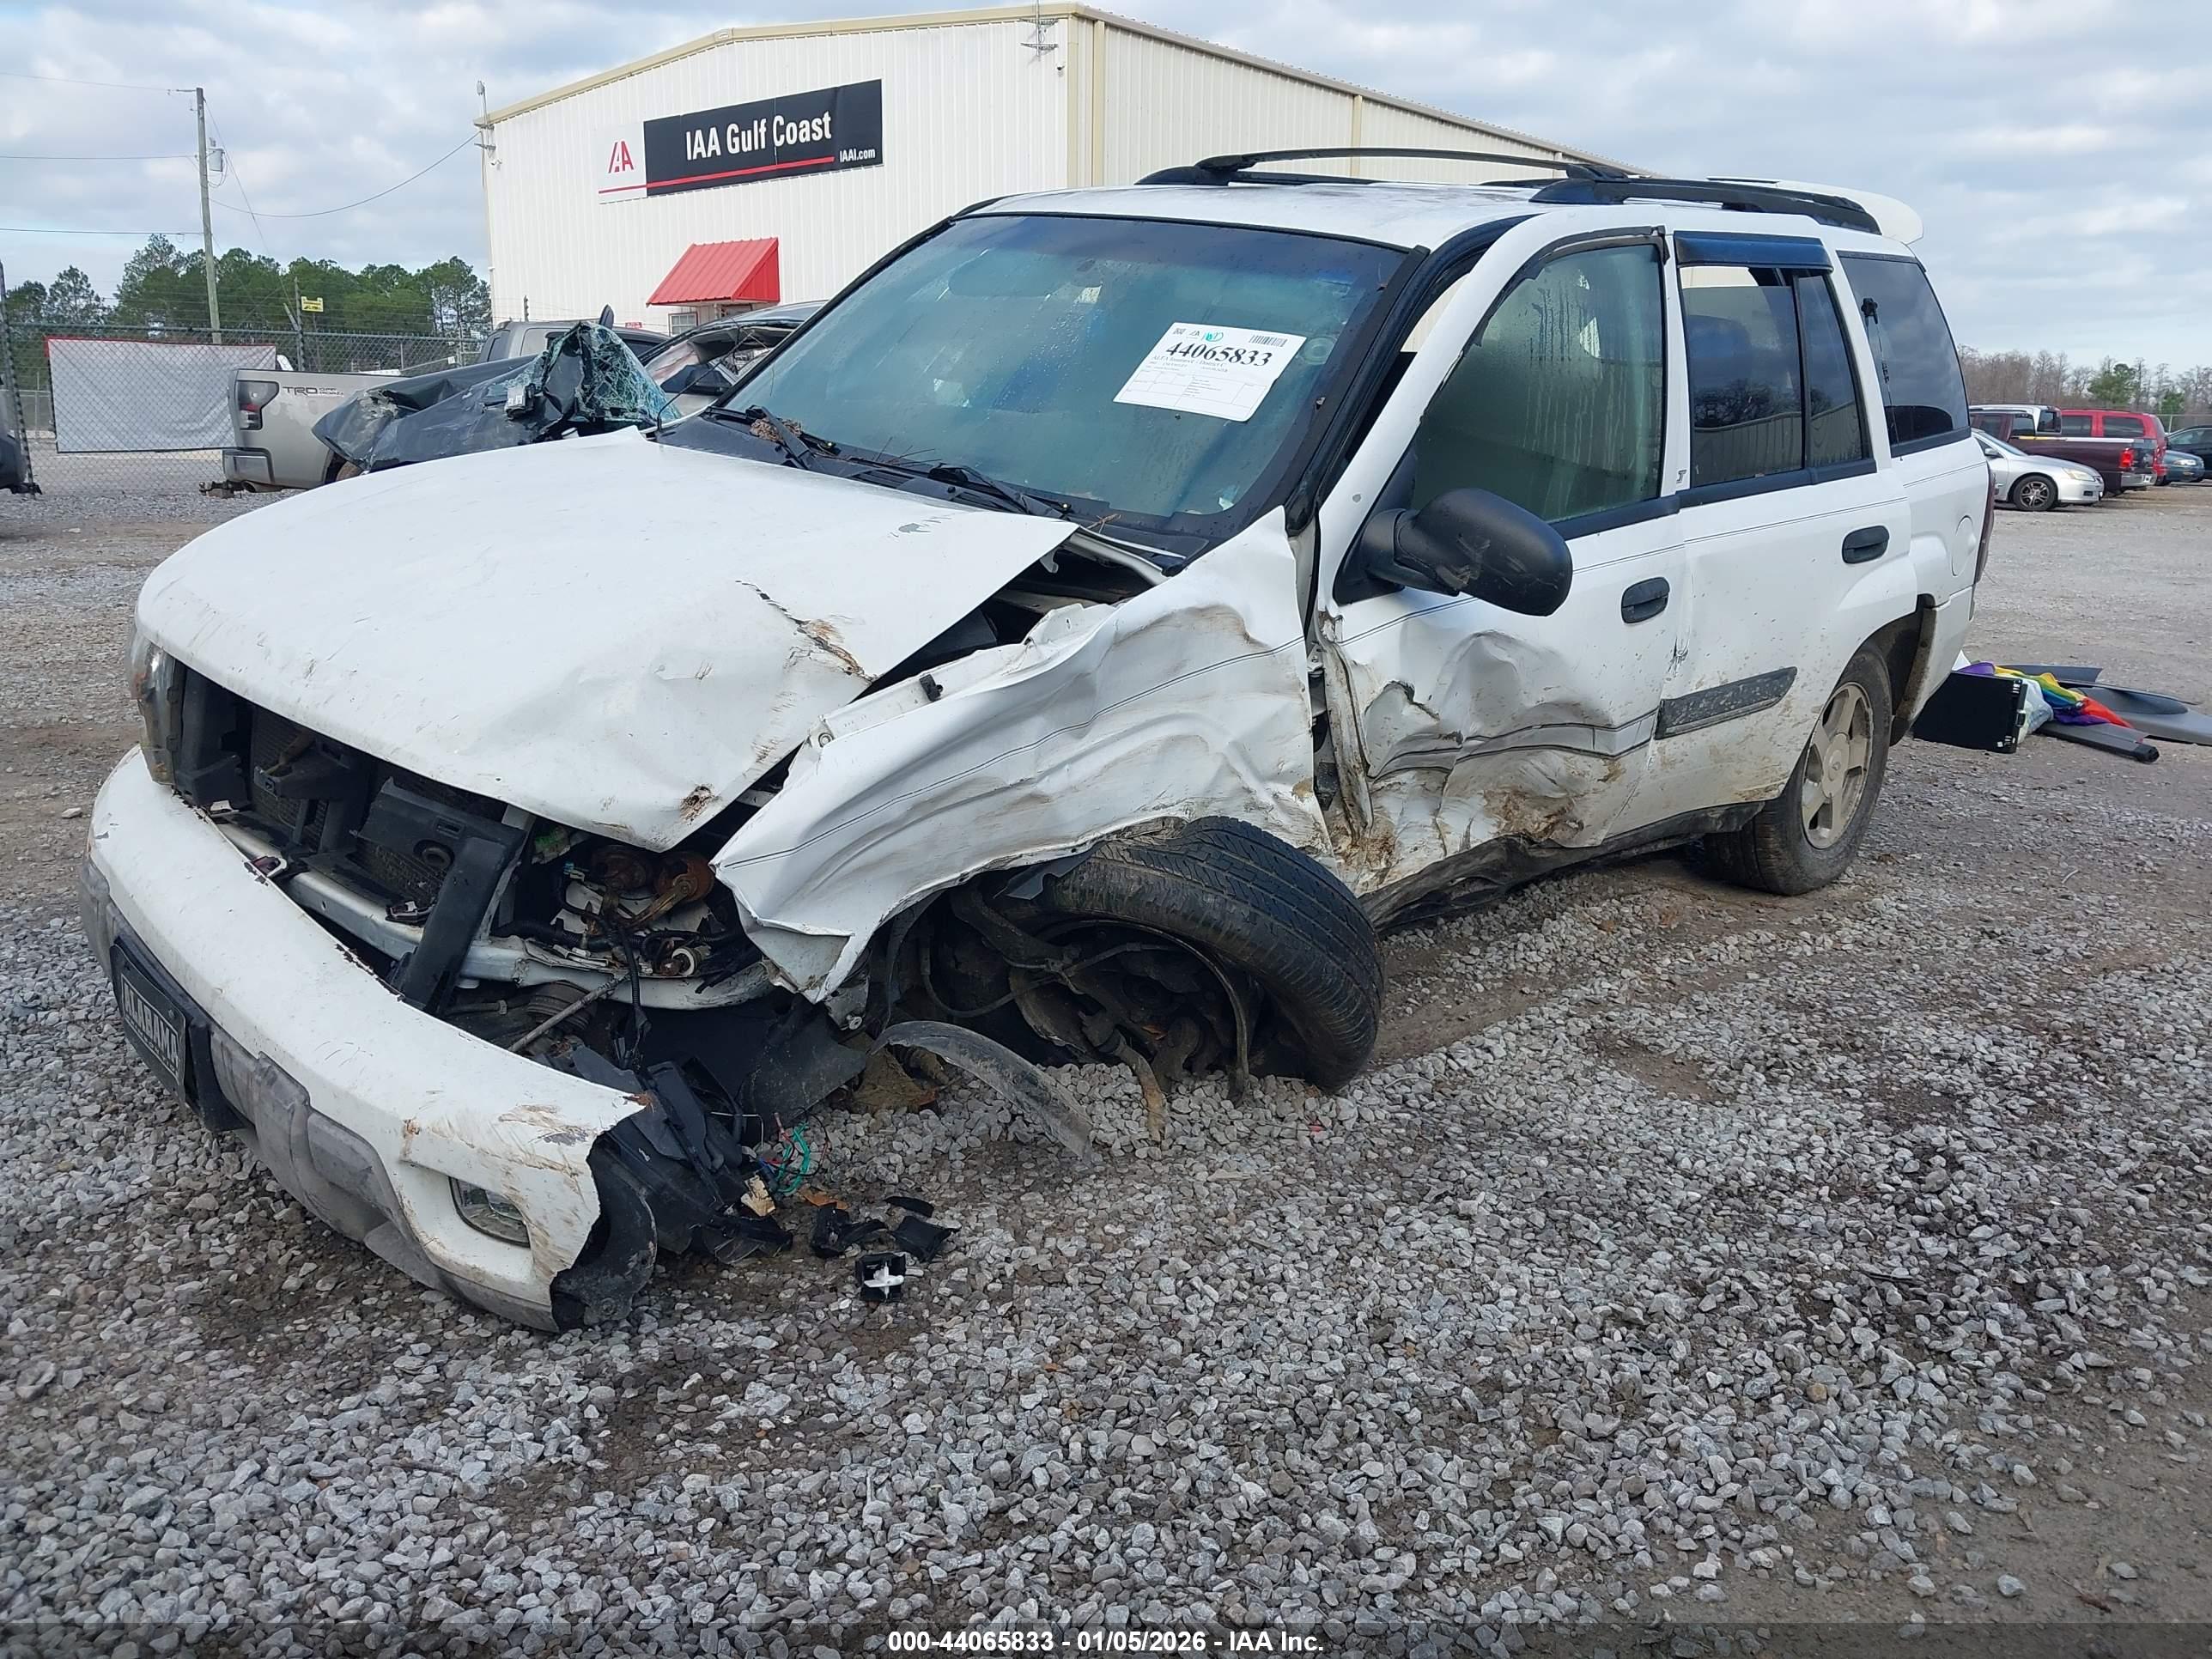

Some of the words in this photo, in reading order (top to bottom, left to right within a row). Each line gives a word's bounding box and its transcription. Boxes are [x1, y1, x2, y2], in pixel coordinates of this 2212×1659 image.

[686, 127, 721, 161] IAA
[726, 118, 767, 155] Gulf
[773, 111, 832, 148] Coast
[1166, 342, 1273, 367] 44065833
[283, 386, 318, 396] TRD
[124, 981, 179, 1067] ALABAMA
